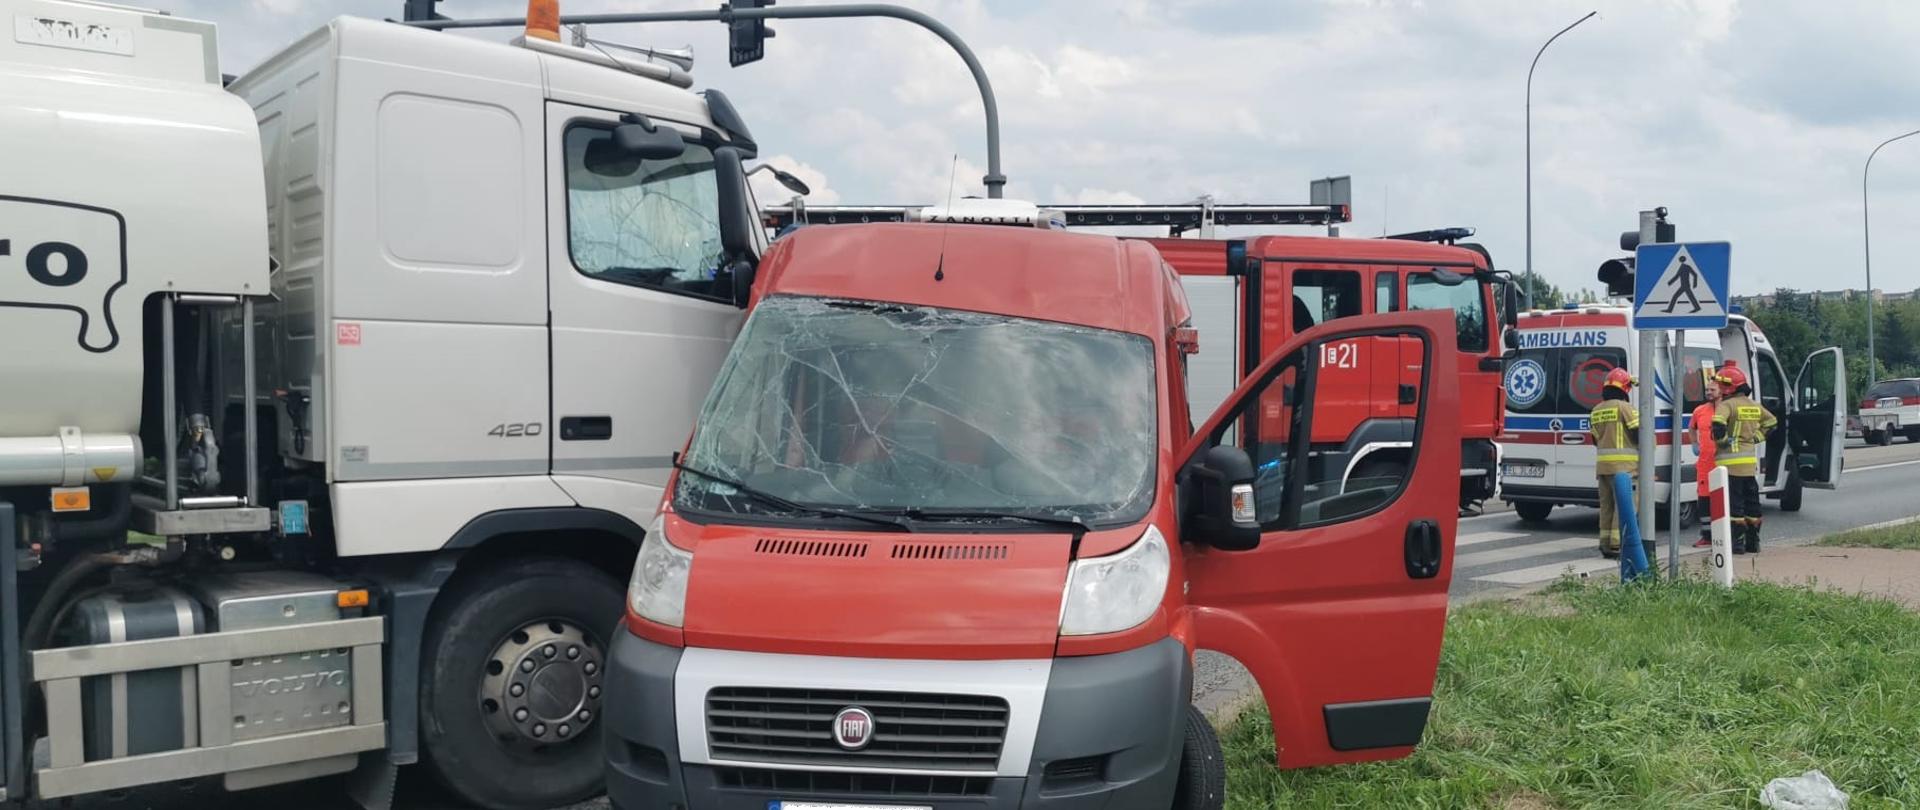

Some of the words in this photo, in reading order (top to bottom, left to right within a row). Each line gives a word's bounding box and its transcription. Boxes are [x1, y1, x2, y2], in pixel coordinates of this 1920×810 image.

[930, 215, 1030, 223] ZANOTTI
[487, 422, 542, 438] 420
[1715, 553, 1724, 568] 0
[843, 719, 865, 738] FIAT
